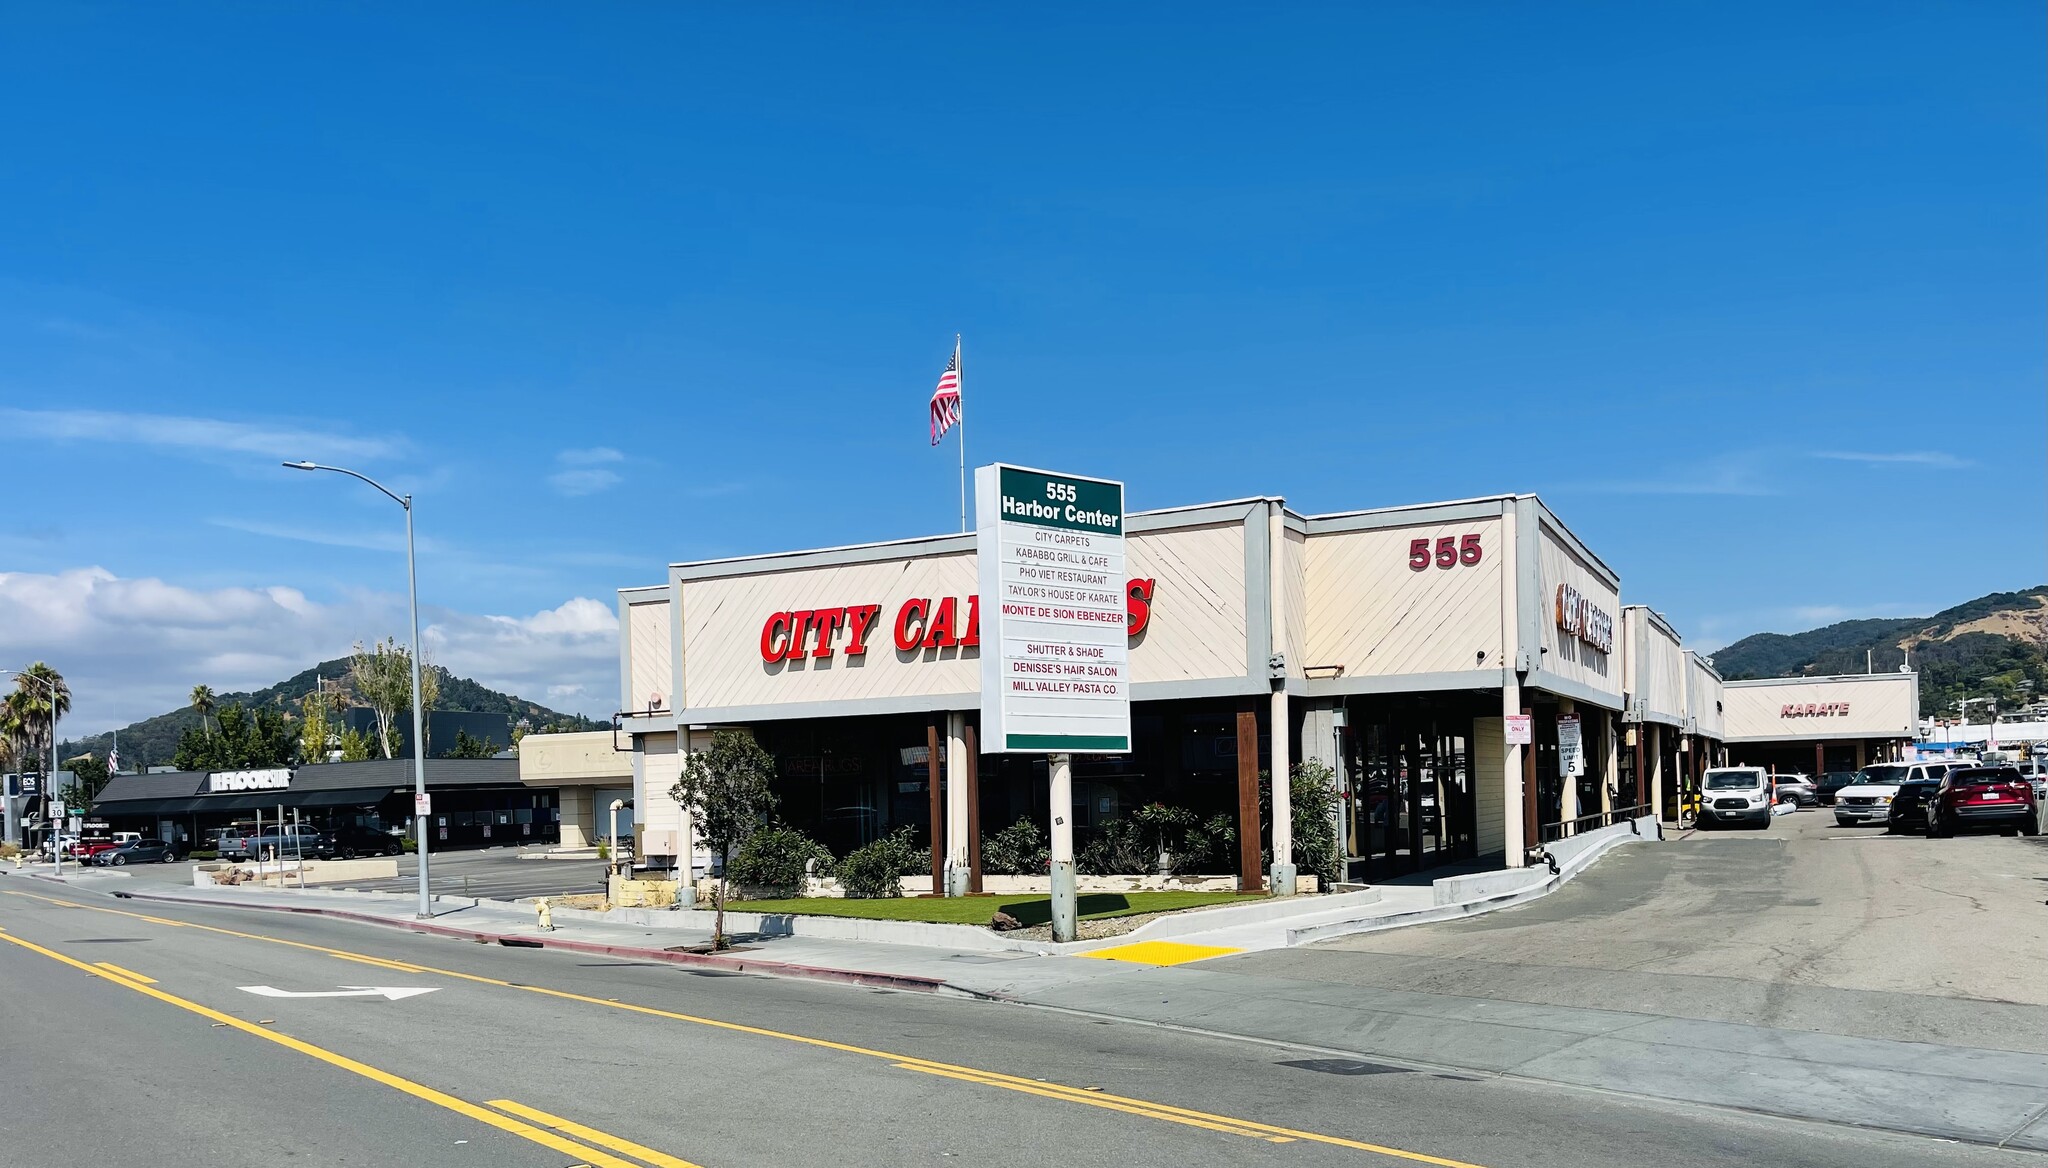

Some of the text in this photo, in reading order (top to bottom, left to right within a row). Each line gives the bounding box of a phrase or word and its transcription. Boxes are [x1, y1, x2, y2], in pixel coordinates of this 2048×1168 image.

[1046, 482, 1076, 502] 555
[1002, 496, 1118, 527] Harbor Center
[1035, 531, 1090, 547] CITY CARPETS
[1016, 547, 1108, 567] KABABBQ GRILL & CAFE
[1409, 534, 1482, 568] 555
[1020, 567, 1107, 585] PHO VIET RESTAURANT
[1008, 585, 1118, 604] TAYLOR'S HOUSE OF KARATE
[1002, 605, 1124, 623] MONTE DE SION EBENEZER
[760, 604, 879, 664] CITY
[1027, 644, 1104, 658] SHUTTER & SHADE
[1013, 662, 1117, 676] DENISSE'S HAIR SALON
[1012, 681, 1118, 694] MILL VALLEY PASTA CO.
[1781, 702, 1849, 718] KARATE
[1568, 762, 1575, 772] 5
[222, 770, 272, 790] FLOOR
[52, 809, 62, 817] 30
